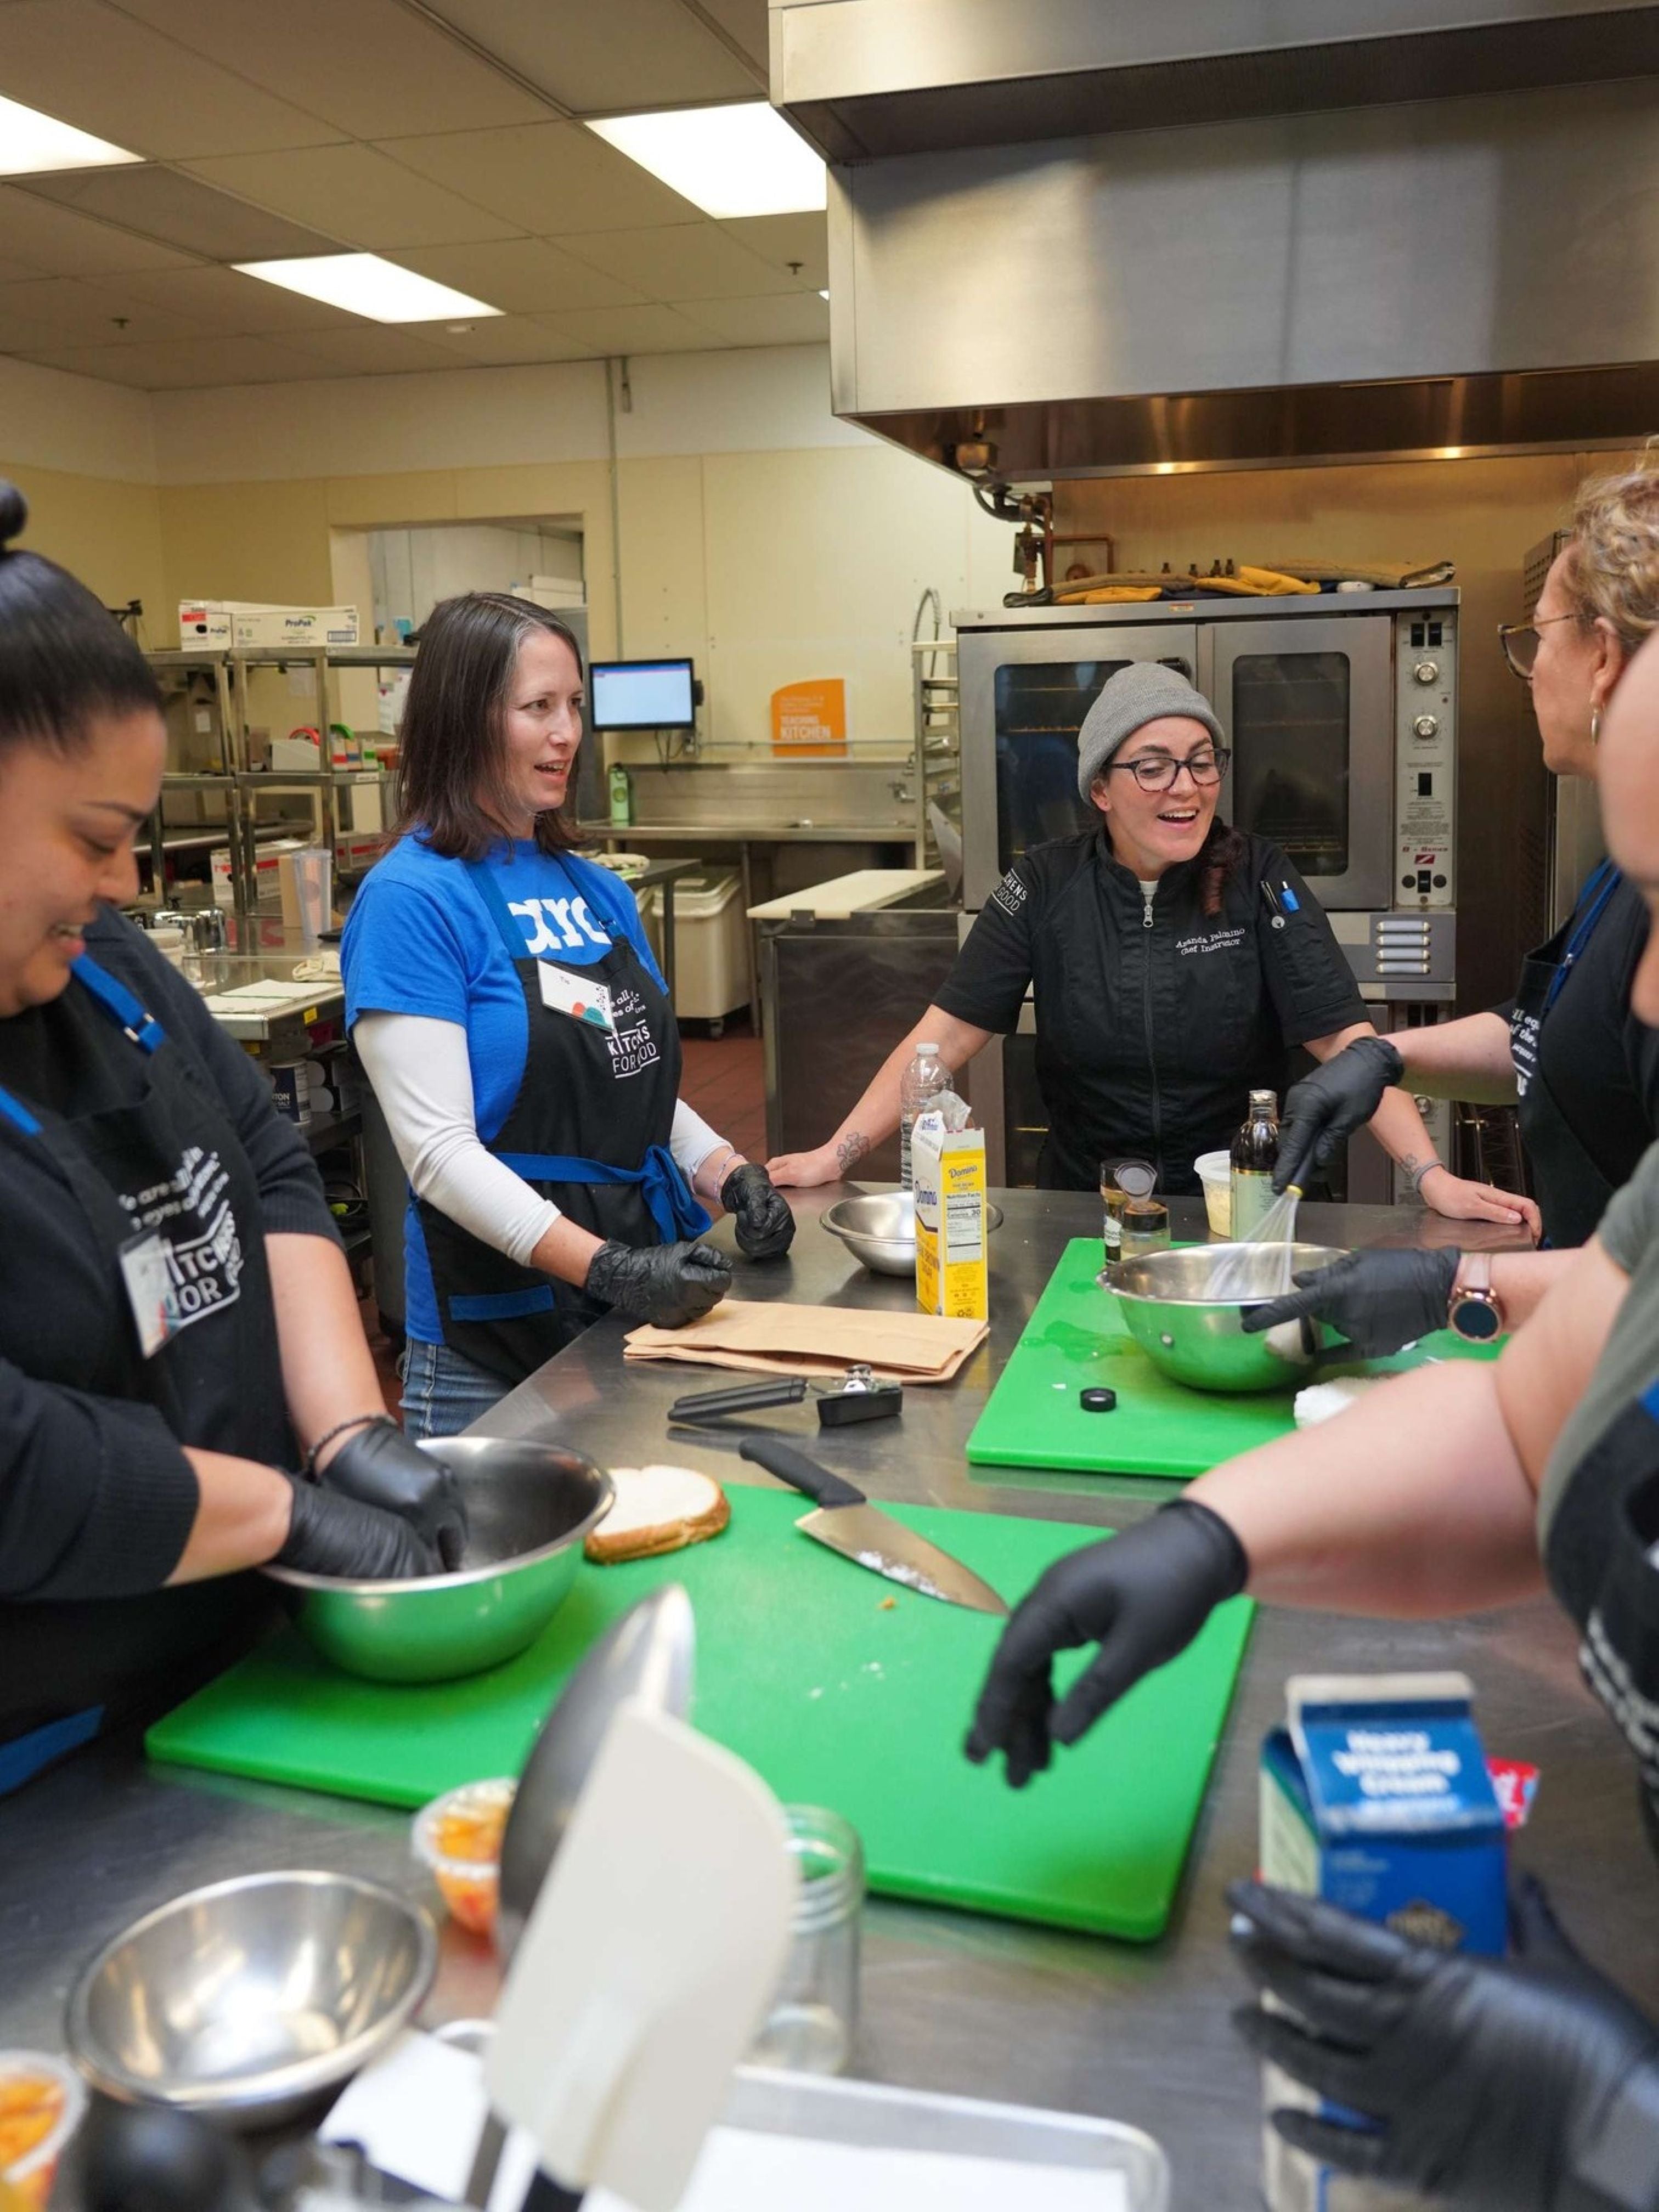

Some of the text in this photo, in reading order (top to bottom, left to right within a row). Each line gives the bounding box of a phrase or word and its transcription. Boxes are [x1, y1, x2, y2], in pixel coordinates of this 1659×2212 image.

[285, 618, 312, 627] ProPak
[780, 725, 831, 740] KITCHEN
[507, 896, 612, 955] arc
[612, 1053, 637, 1073] FOR
[949, 1165, 978, 1179] Domino
[915, 1180, 938, 1206] Domino
[142, 1200, 182, 1227] eyes
[1359, 1773, 1451, 1797] Cream
